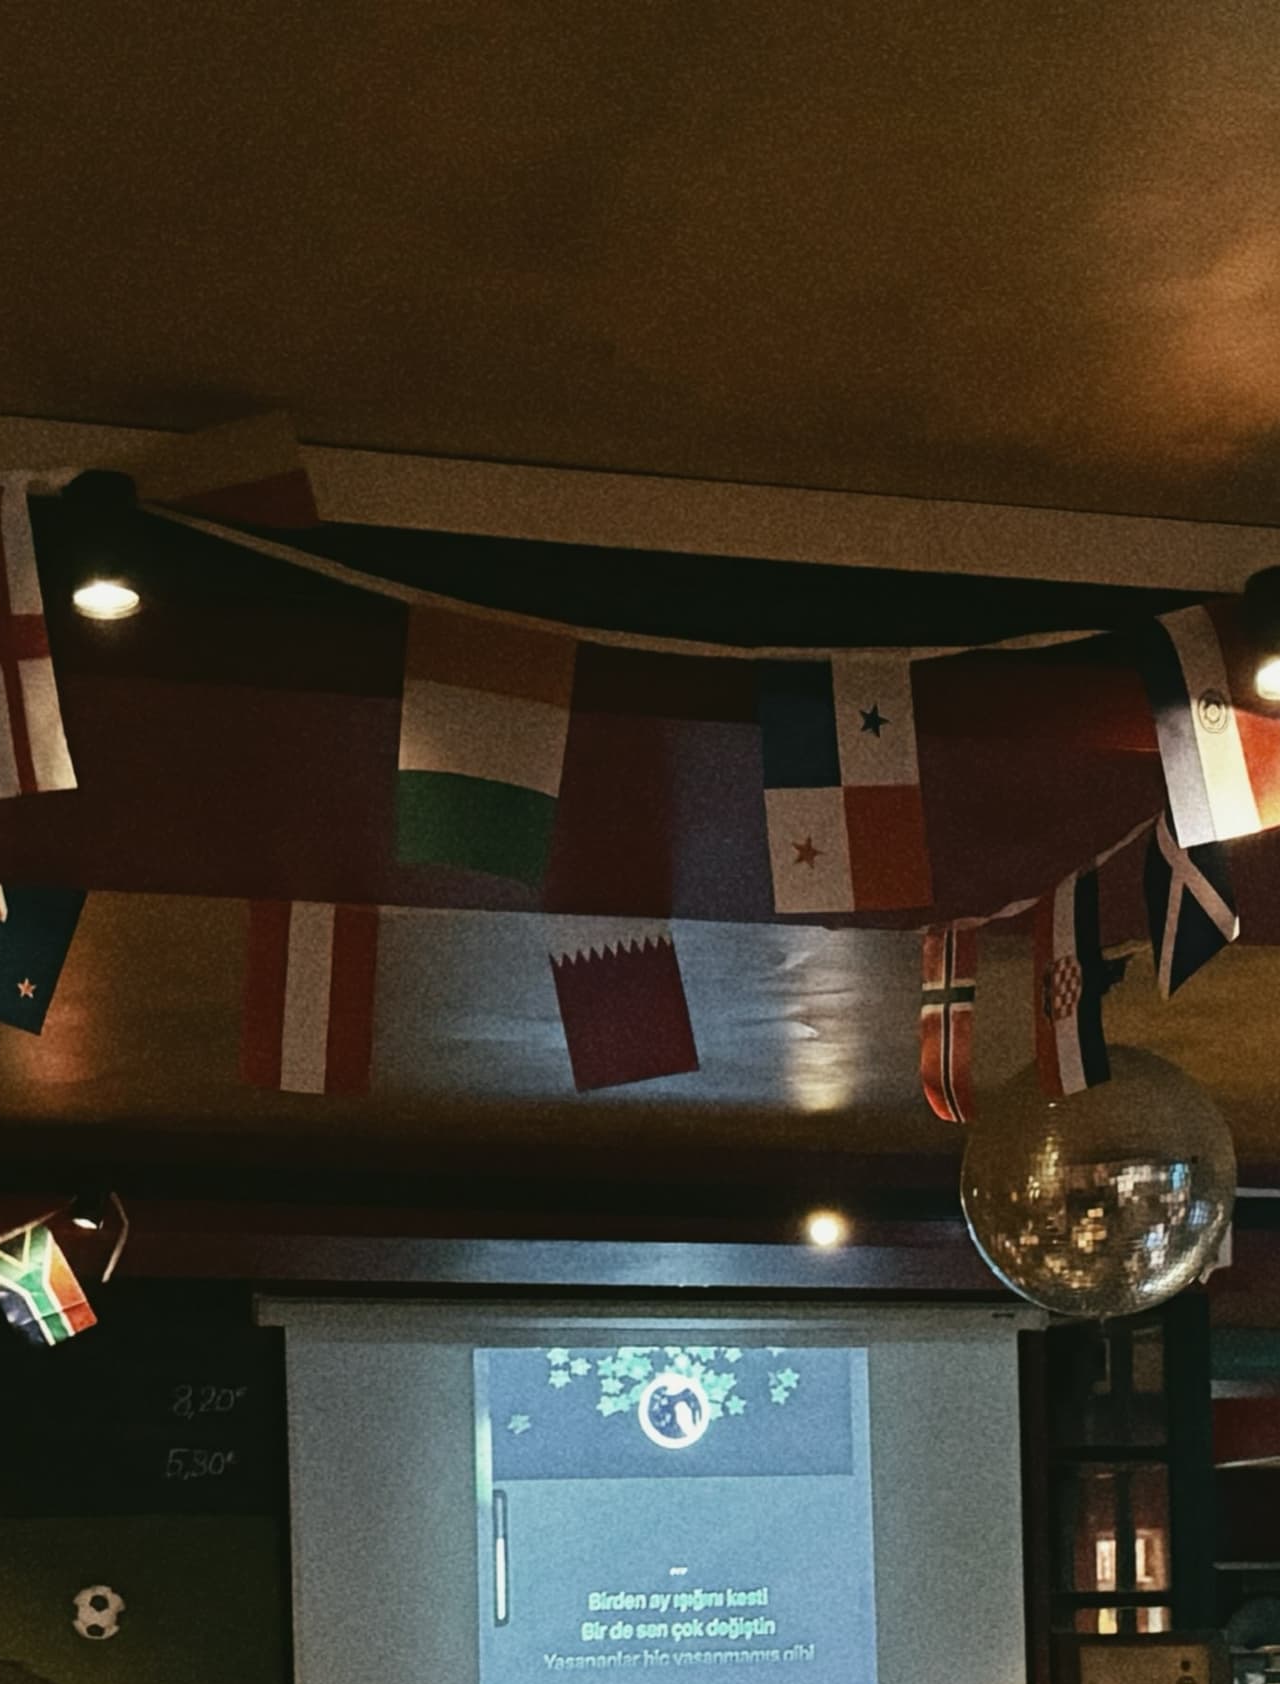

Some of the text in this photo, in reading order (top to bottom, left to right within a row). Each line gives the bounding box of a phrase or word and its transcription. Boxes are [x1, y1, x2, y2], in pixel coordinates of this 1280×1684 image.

[588, 1591, 646, 1611] Birden
[581, 1621, 608, 1641] Bir
[609, 1621, 634, 1639] de
